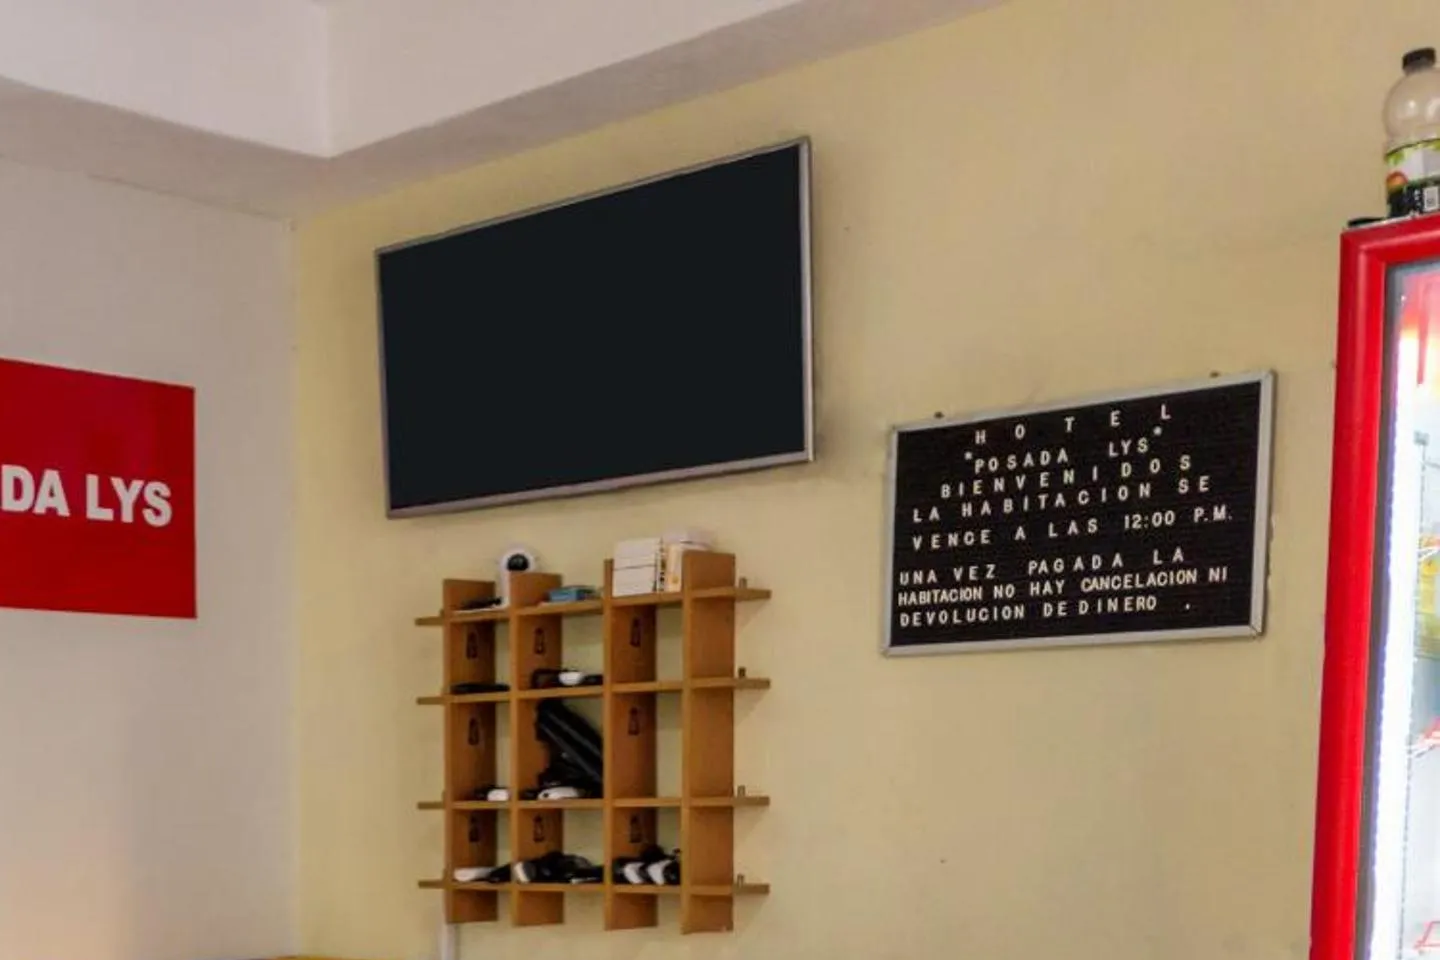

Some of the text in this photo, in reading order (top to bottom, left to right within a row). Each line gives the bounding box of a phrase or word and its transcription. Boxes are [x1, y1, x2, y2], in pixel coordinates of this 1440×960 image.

[975, 404, 1171, 445] HOTEL
[1108, 437, 1148, 457] LYS
[940, 454, 1191, 499] BIENVENIDOS
[86, 474, 172, 527] LYS
[913, 475, 1209, 523] LA HABITACION SE
[912, 504, 1232, 550] VENCE A LAS 12:00 P.M.
[897, 566, 1228, 606] HABITACION NO HAY CANCELACION NI
[899, 547, 1184, 586] UNA VEZ PAGADA LA
[899, 595, 1157, 627] DEVOLUCION DE DINERO
